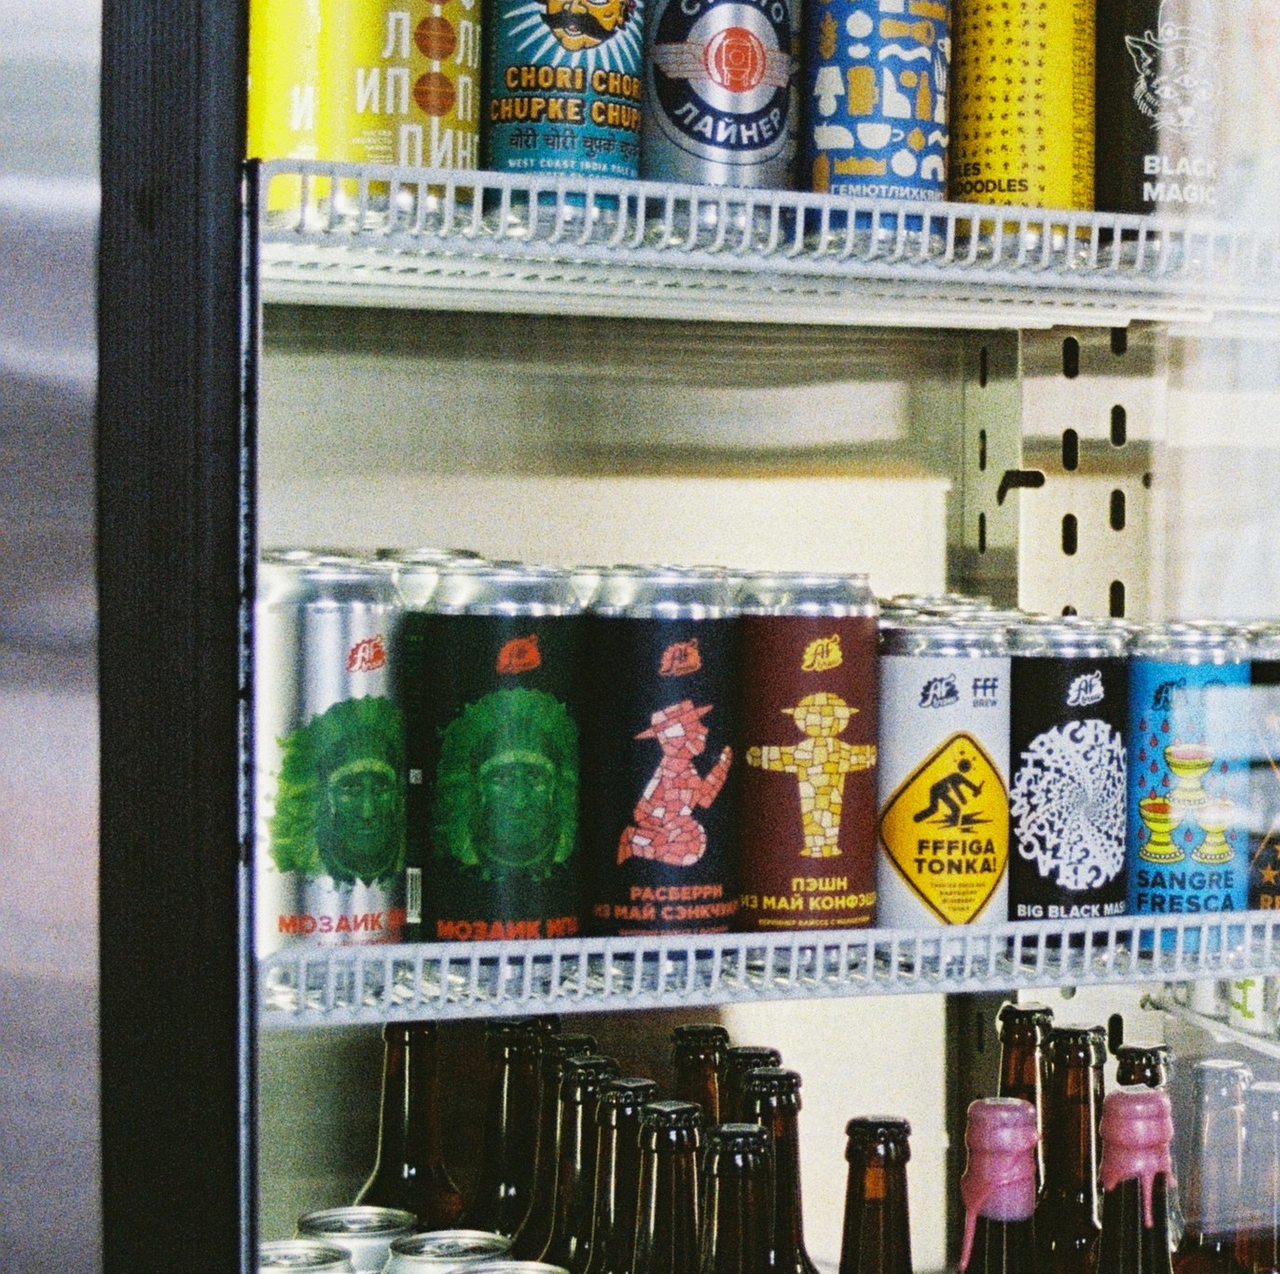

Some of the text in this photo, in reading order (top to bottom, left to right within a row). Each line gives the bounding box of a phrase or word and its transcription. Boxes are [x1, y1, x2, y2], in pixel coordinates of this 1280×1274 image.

[506, 65, 584, 90] CHORI
[490, 97, 582, 121] CHUPKE
[675, 103, 782, 146] ЛАЙНЕР
[508, 158, 534, 168] WEST
[540, 158, 576, 169] COAST
[1143, 182, 1214, 205] MAGIC
[918, 839, 995, 855] FFFIGA
[914, 857, 997, 874] TONKA!
[792, 875, 848, 892] ПЭШН
[1137, 870, 1234, 890] SANGRE
[763, 893, 804, 911] МАЙ
[1017, 904, 1044, 918] BIG
[1048, 904, 1101, 918] BLACK
[1137, 893, 1235, 913] FRESCA
[278, 912, 383, 935] МОЗАИК
